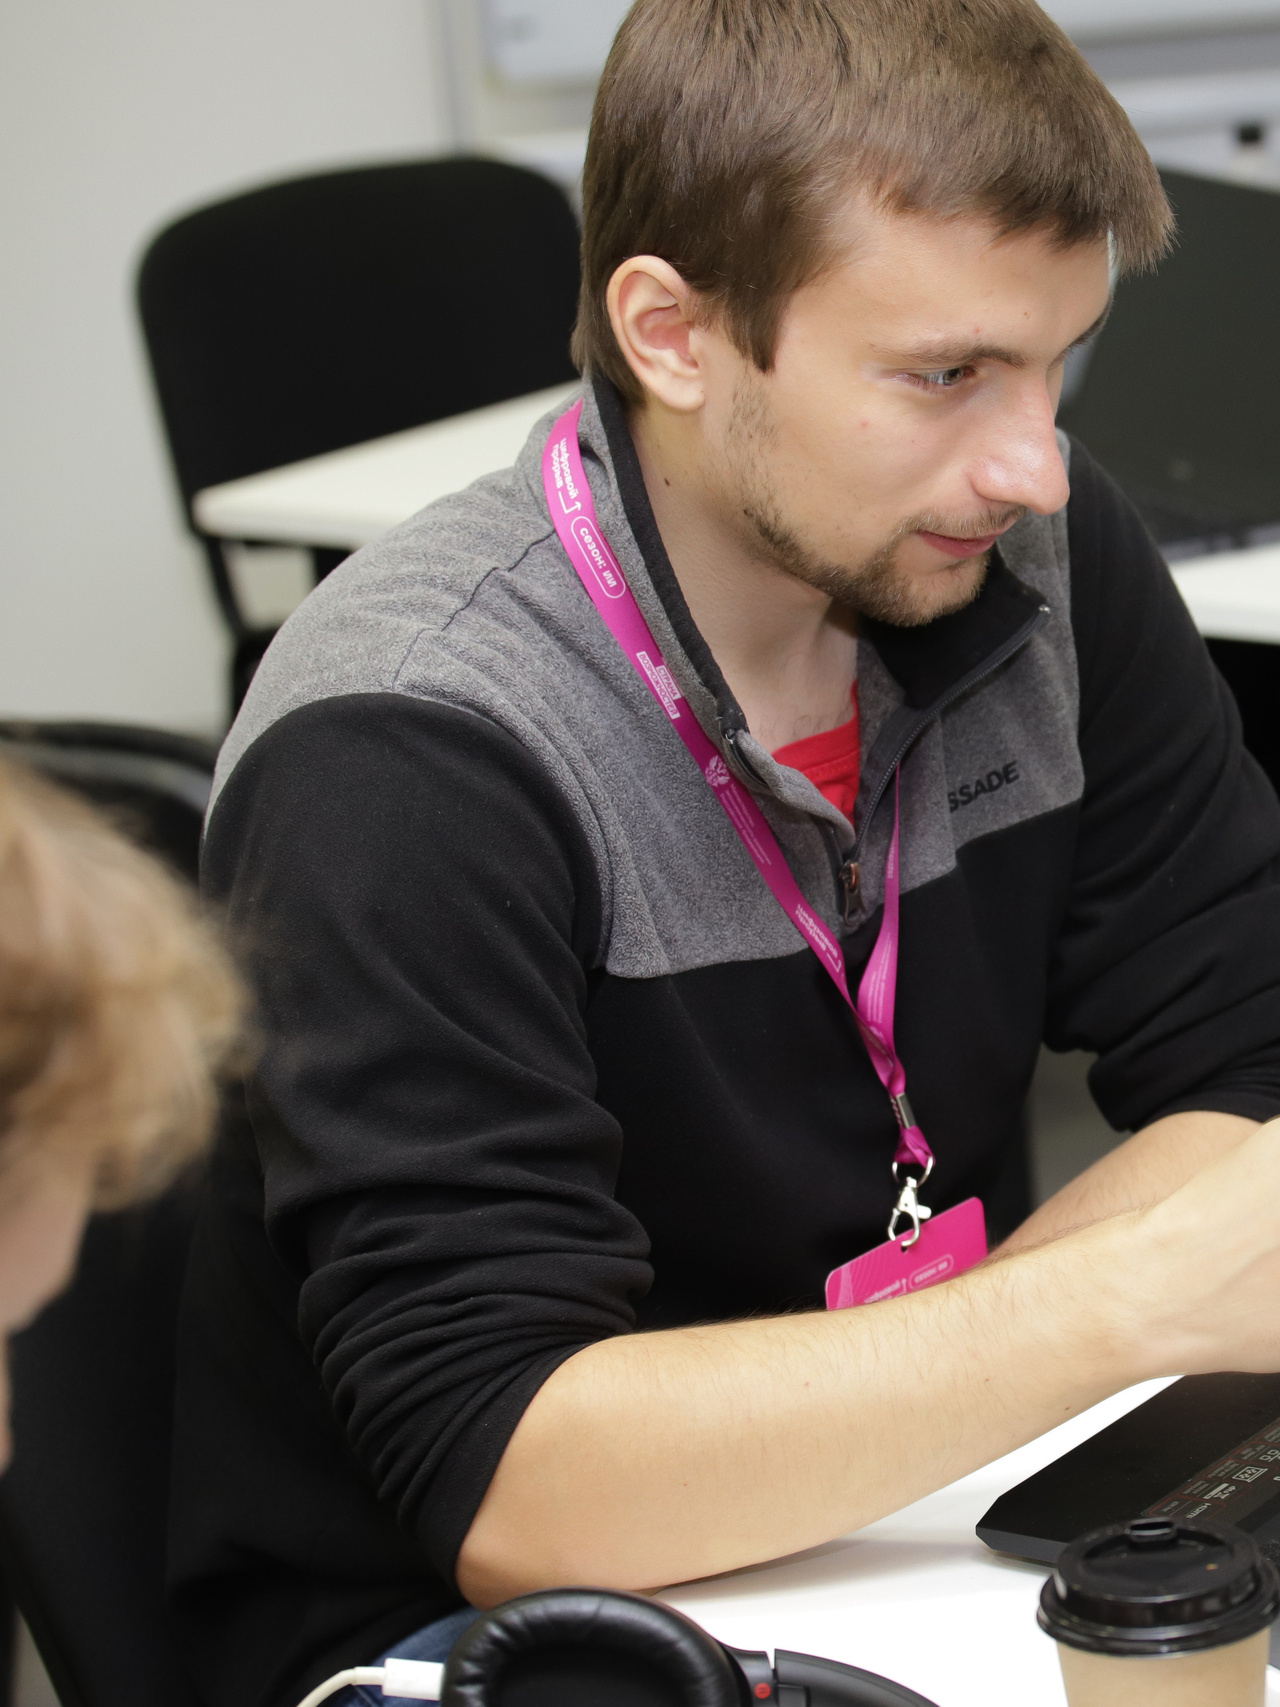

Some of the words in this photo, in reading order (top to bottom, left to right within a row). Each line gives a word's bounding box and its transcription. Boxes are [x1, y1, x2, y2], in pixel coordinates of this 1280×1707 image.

[552, 444, 564, 489] прорыв
[559, 438, 580, 499] цифровой
[579, 527, 607, 569] сезон:
[638, 652, 679, 717] ВОЗМОЖНОСТЕЙ
[656, 666, 681, 698] СТРАНА
